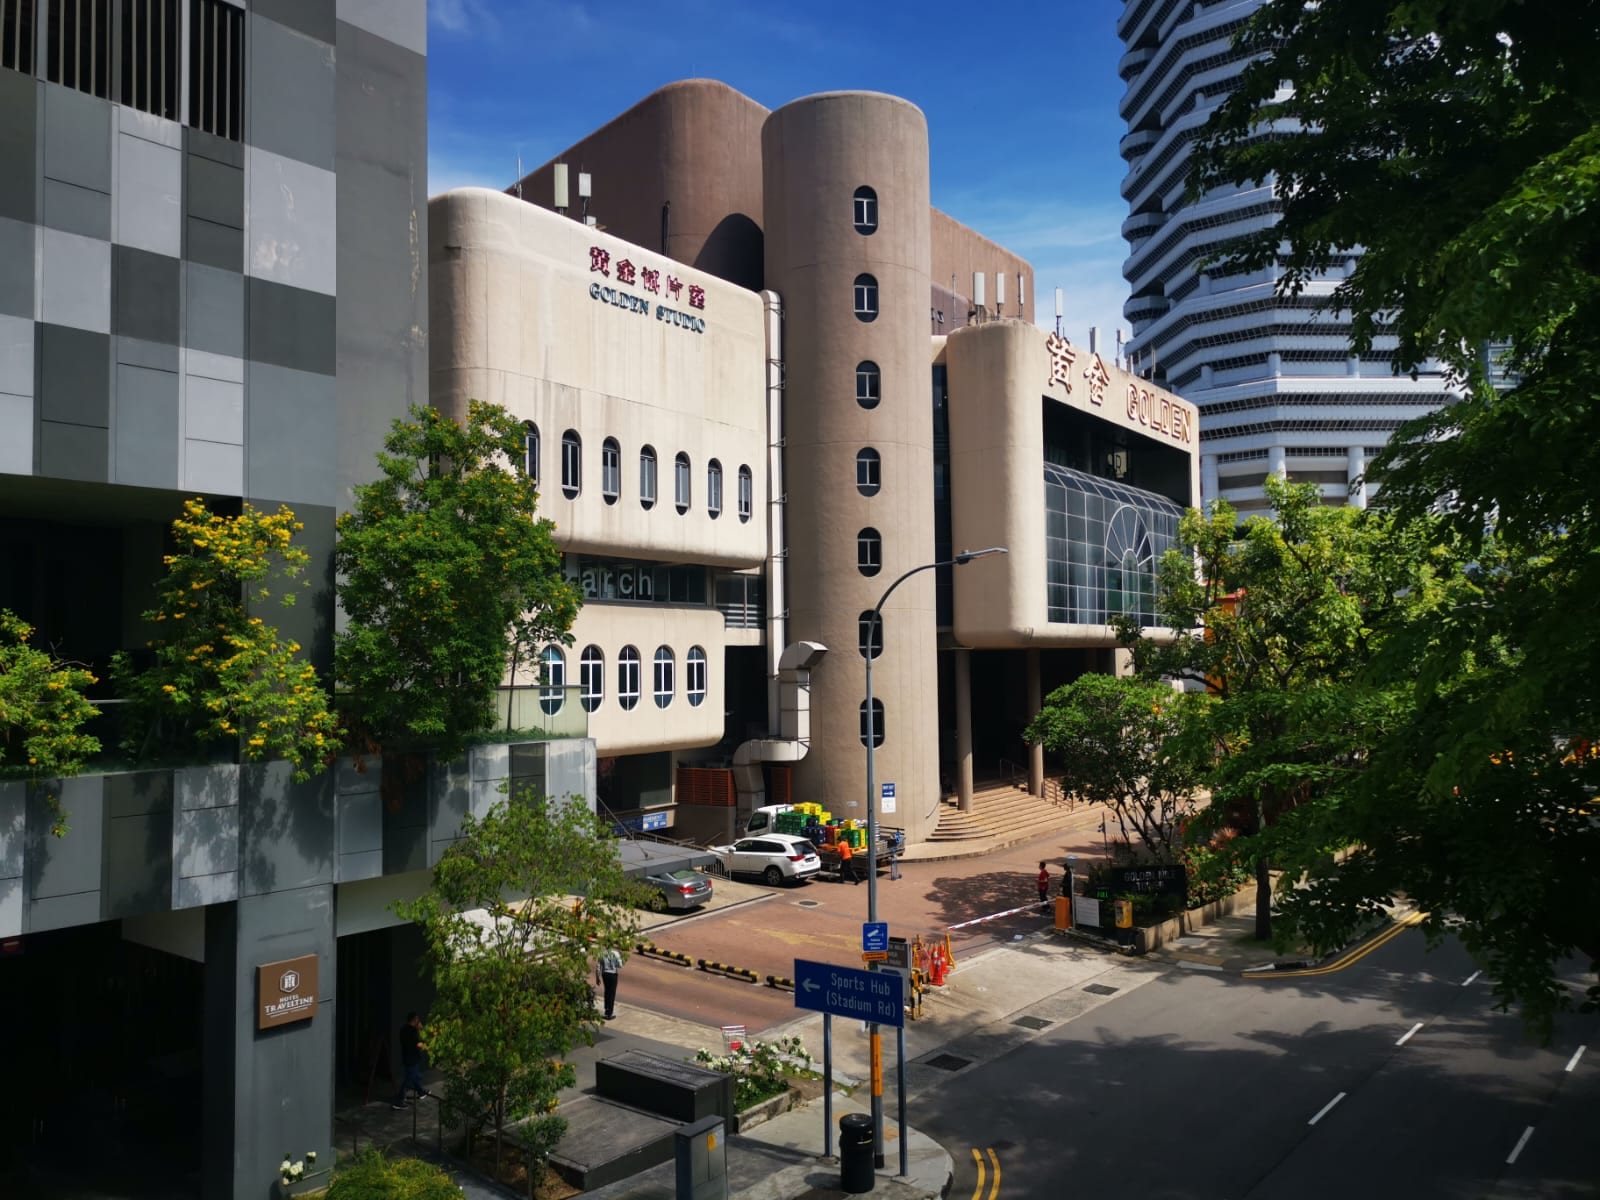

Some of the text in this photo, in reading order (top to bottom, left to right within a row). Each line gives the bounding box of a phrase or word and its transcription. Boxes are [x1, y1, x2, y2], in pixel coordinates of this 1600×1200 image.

[589, 282, 706, 334] GOLDEN STUDIO
[1126, 383, 1192, 443] GOLDEN
[831, 973, 891, 996] Sports Hub
[264, 996, 314, 1013] TRAVELTINE
[280, 994, 299, 1003] HOTEL
[826, 990, 896, 1019] (Stadium Rd)
